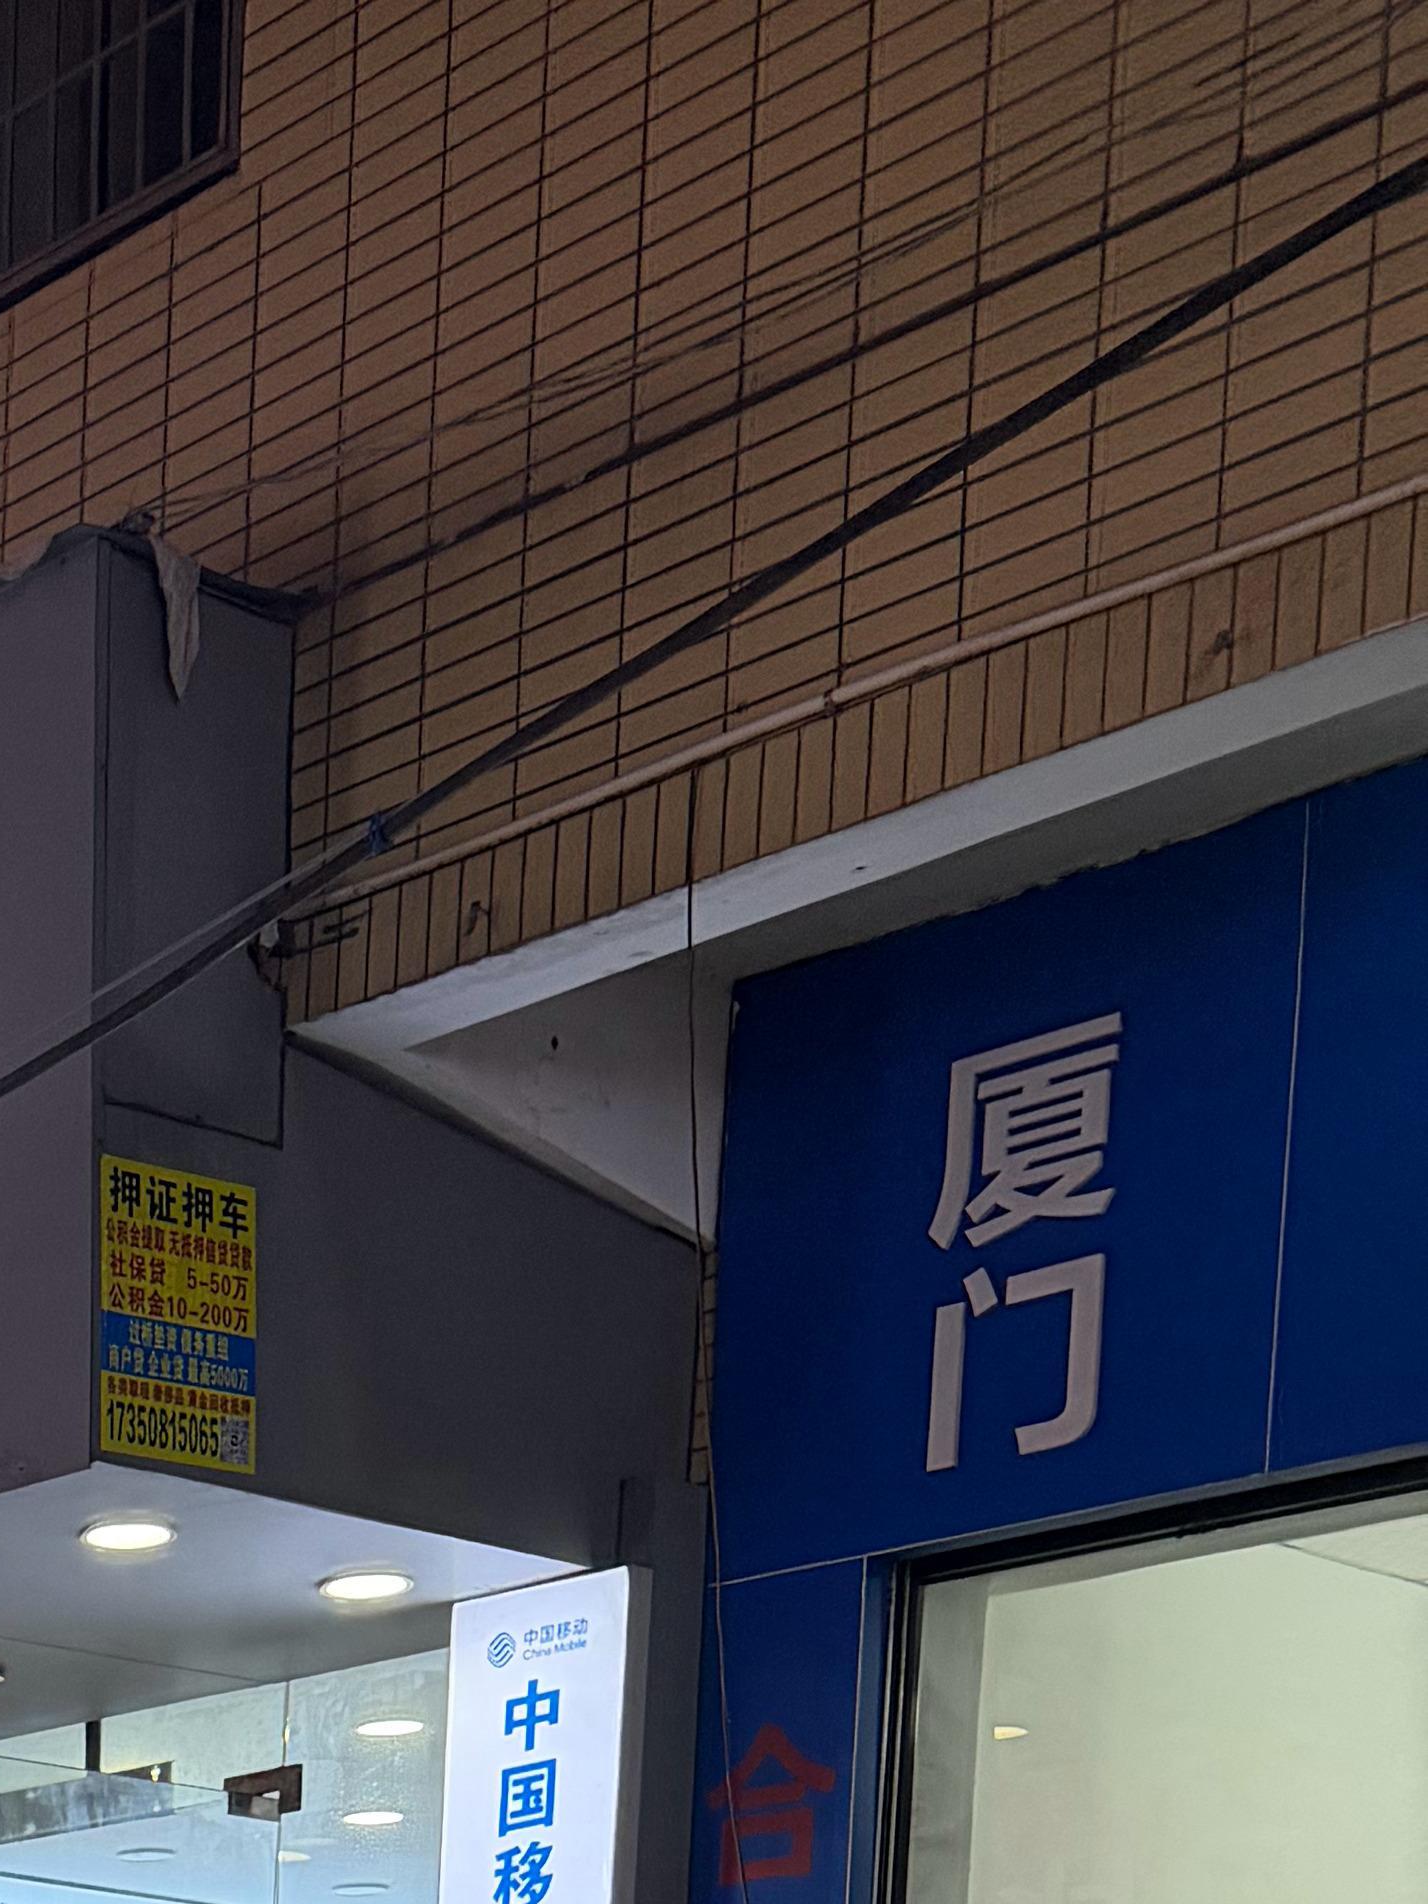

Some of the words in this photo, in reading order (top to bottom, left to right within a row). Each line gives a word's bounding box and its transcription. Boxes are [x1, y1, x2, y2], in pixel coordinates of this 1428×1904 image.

[108, 1166, 249, 1240] 押证押车
[922, 1010, 1124, 1474] 厦门
[109, 1253, 166, 1286] 社保贷
[187, 1274, 249, 1302] 5-50万
[106, 1398, 220, 1458] 17350815065
[523, 1617, 589, 1646] 中国移动
